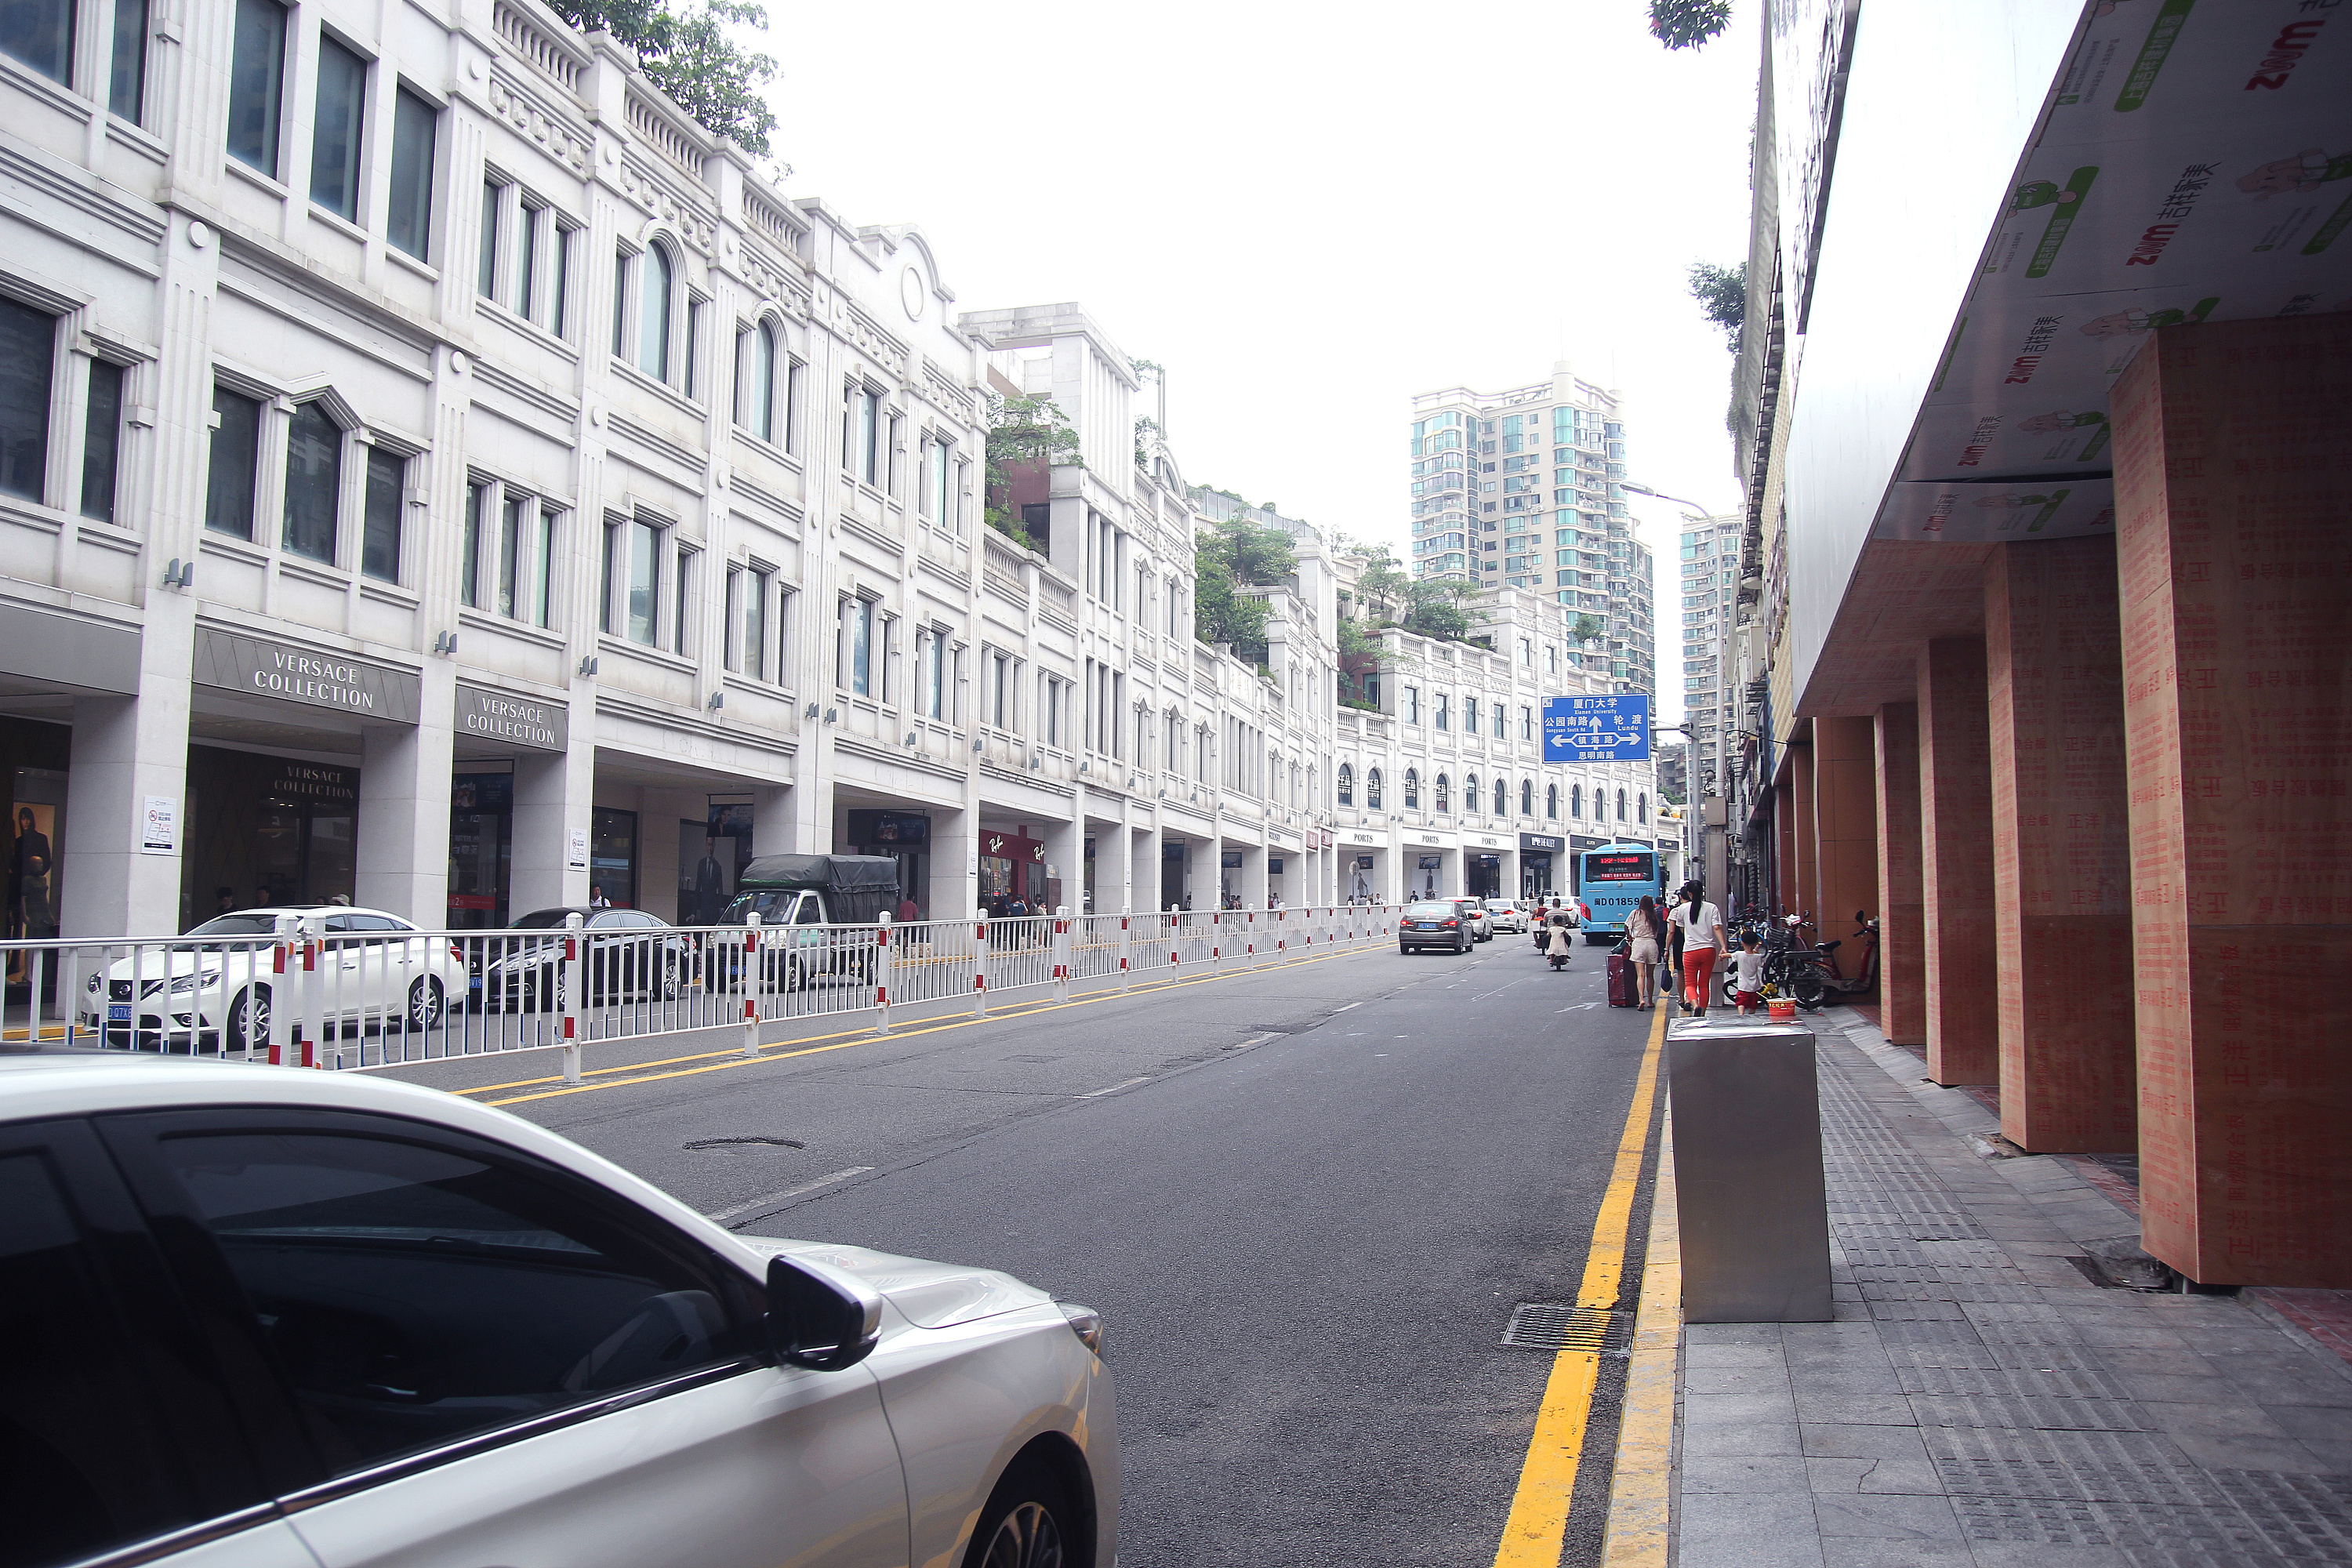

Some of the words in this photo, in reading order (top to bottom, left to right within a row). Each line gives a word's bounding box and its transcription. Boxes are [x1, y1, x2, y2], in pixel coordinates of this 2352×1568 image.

[274, 652, 357, 684] VERSACE
[254, 670, 372, 709] COLLECTION
[1573, 698, 1617, 710] 厦门大学
[482, 697, 543, 724] VERSACE
[1544, 716, 1588, 727] 公园南路
[1613, 714, 1642, 725] 轮渡
[467, 713, 555, 744] COLLECTION
[1577, 735, 1613, 744] 镇海路
[1578, 750, 1615, 760] 思明南路
[288, 766, 343, 783] VERSACE
[274, 779, 354, 799] COLLECTION
[1354, 833, 1374, 844] PORTS
[1421, 835, 1439, 844] PORTS
[1482, 837, 1497, 846] PORTS
